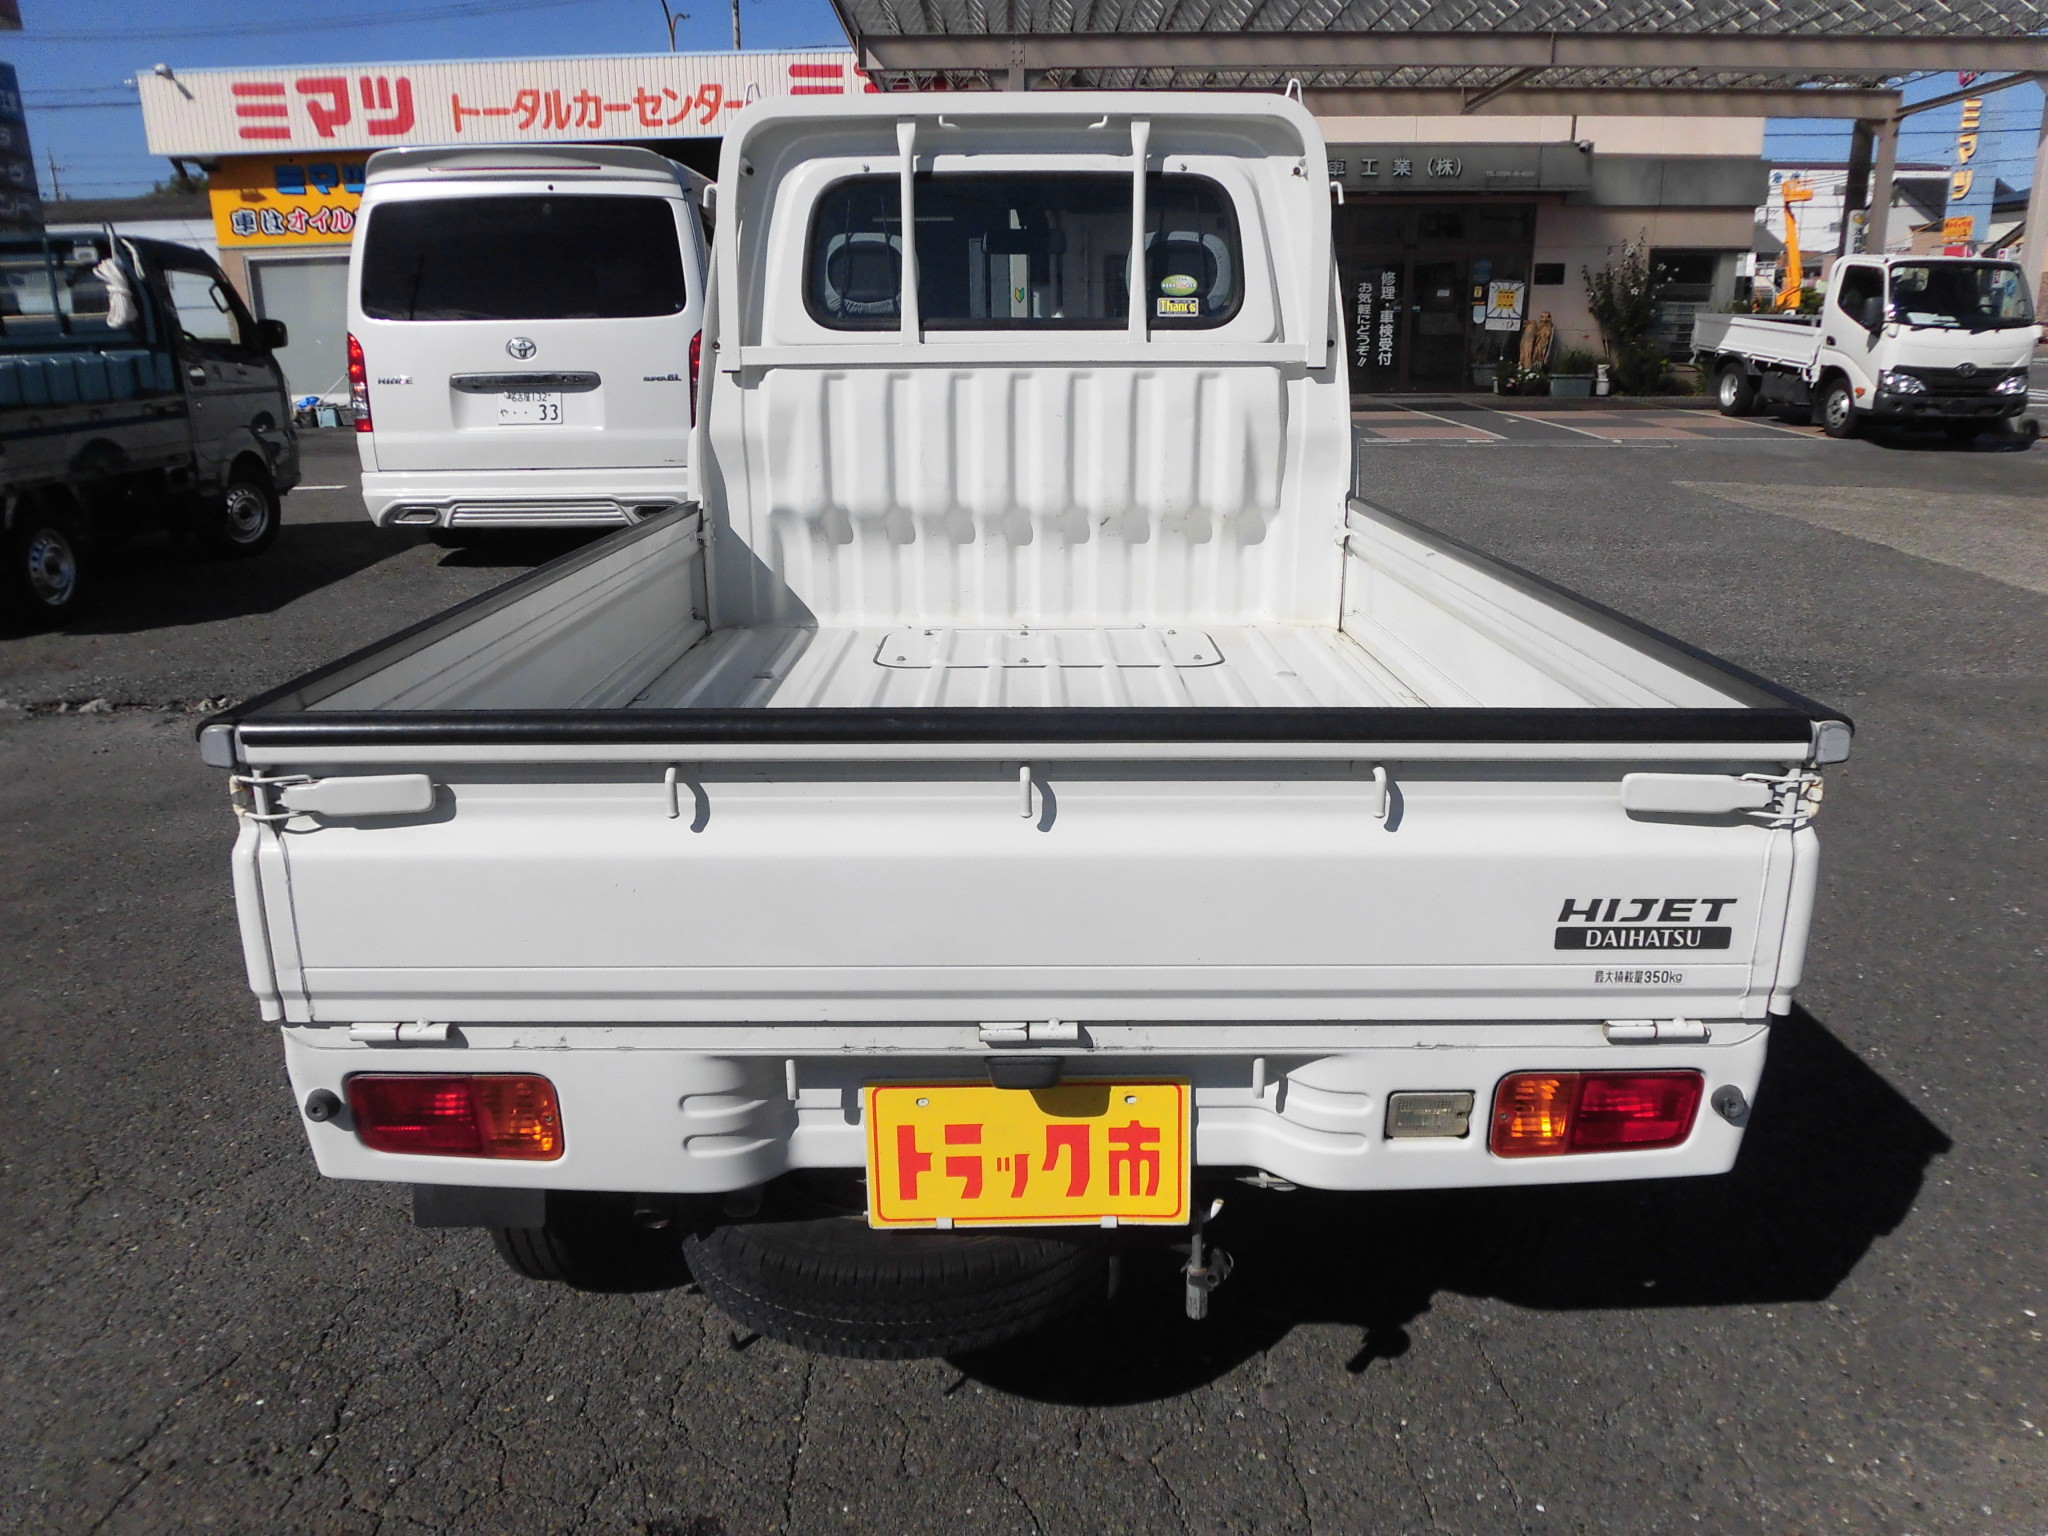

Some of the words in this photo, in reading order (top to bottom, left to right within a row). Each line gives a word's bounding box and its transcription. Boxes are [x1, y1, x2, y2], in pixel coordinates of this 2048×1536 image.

[231, 74, 415, 139] ミマツ
[451, 82, 751, 133] トータルカーセンター
[1378, 271, 1397, 366] 修理・車検受付
[1557, 898, 1739, 923] HIJET
[1585, 929, 1702, 948] DAIHATSU
[897, 1120, 1160, 1201] トラック市
